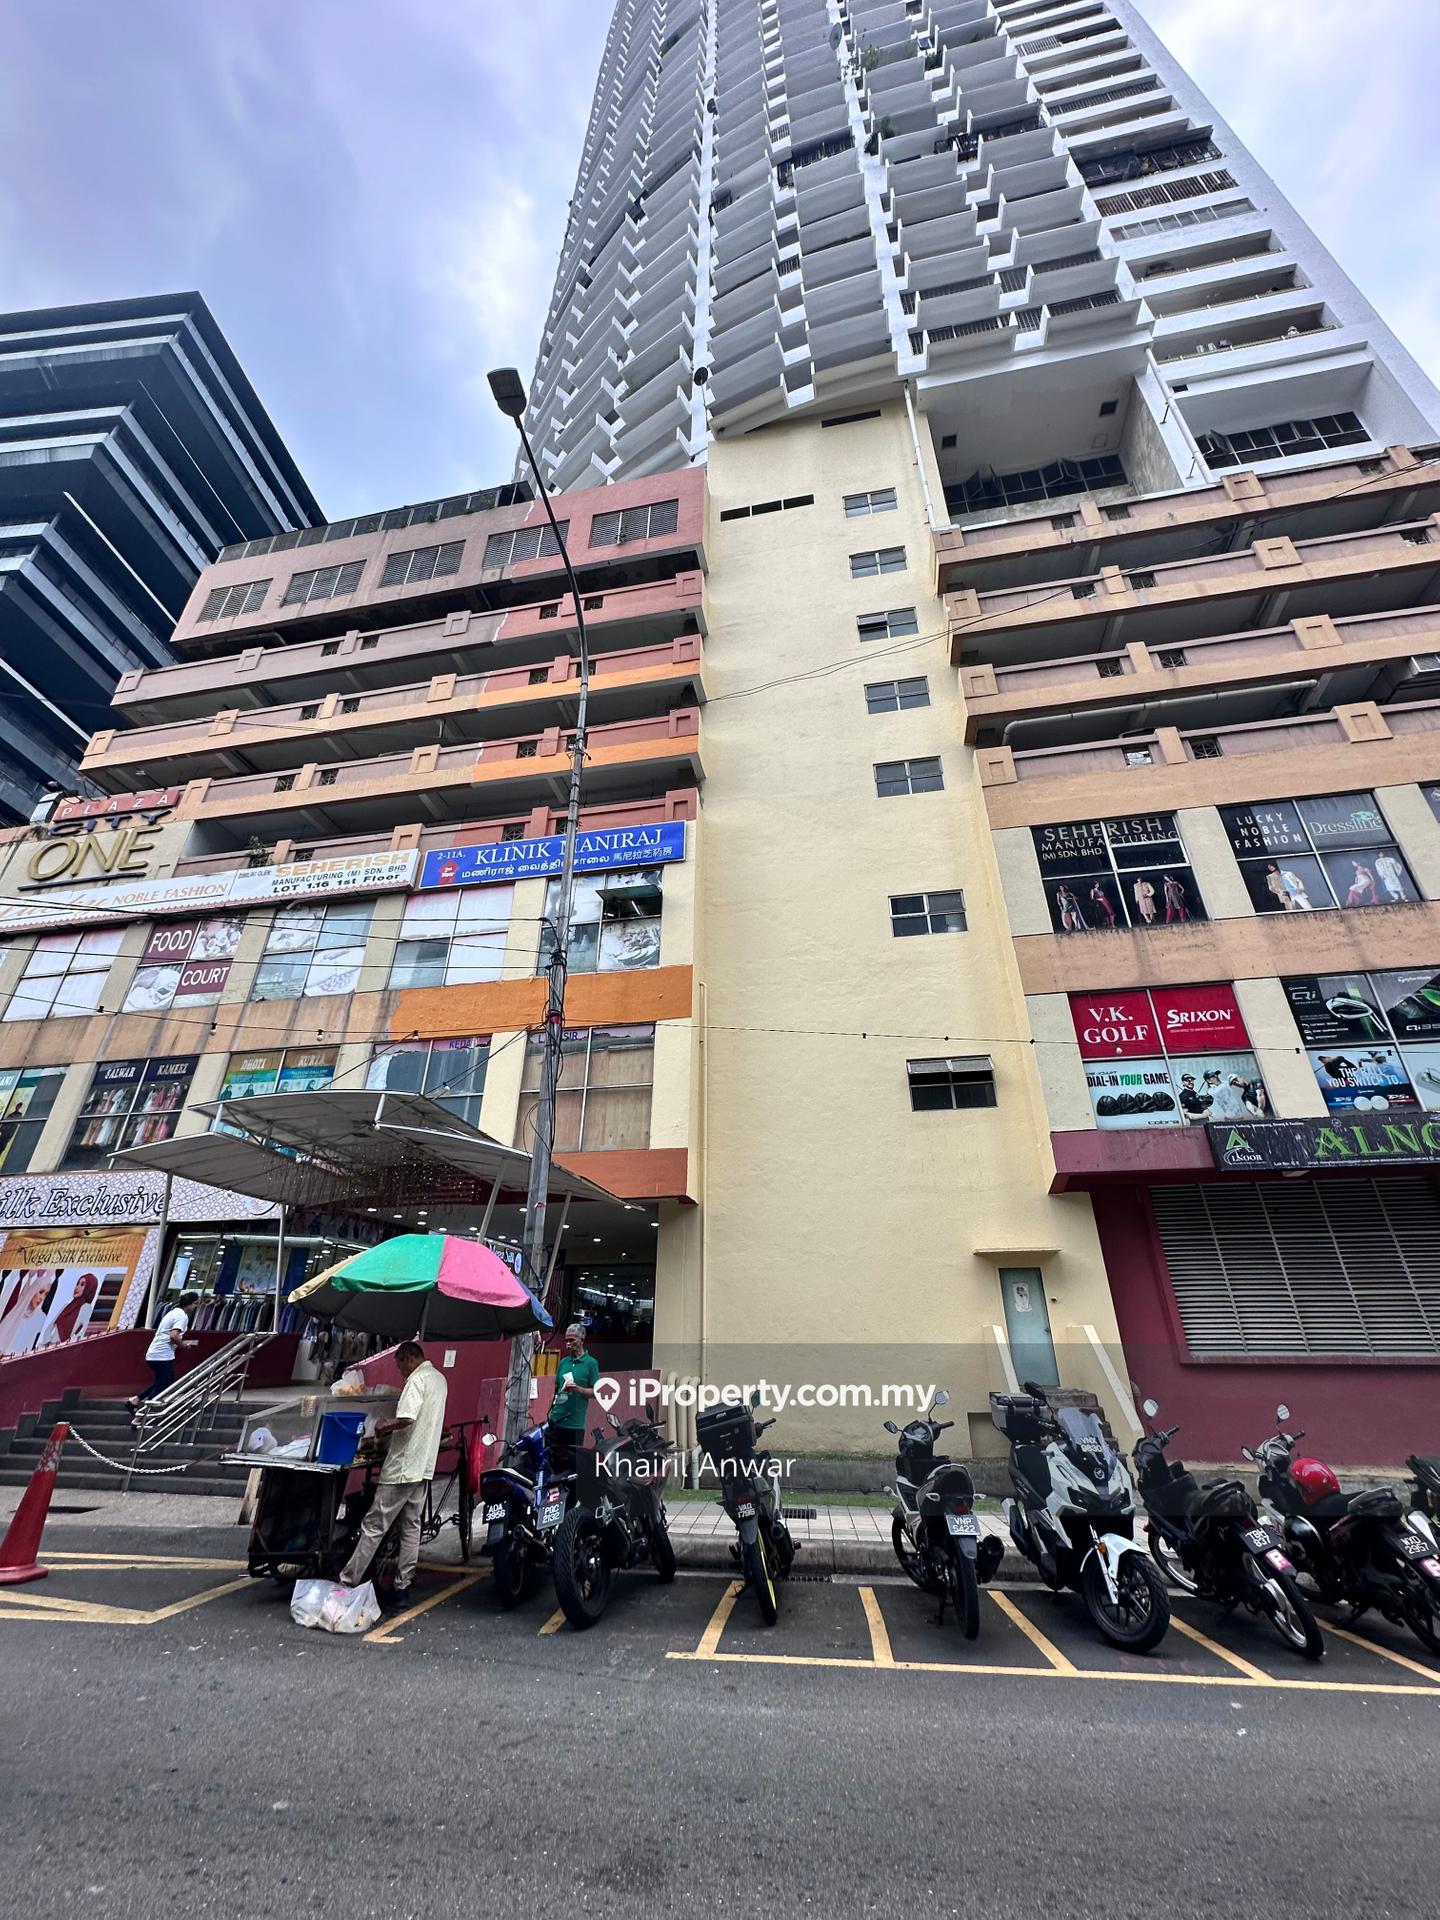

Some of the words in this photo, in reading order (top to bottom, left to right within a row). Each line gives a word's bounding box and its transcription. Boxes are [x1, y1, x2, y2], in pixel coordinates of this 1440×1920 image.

[61, 794, 168, 818] PLAZA
[50, 809, 173, 836] CITY
[1235, 812, 1283, 826] LUCKY
[1309, 815, 1384, 834] Dressline
[1044, 818, 1163, 842] SEHERISH
[1240, 823, 1290, 837] NOBLE
[475, 842, 551, 865] KLINIK
[559, 828, 663, 856] MANIRAJ
[1041, 830, 1178, 852] MANUFACTURING
[1234, 833, 1302, 849] FASHION
[27, 824, 163, 881] ONE
[1042, 852, 1057, 861] (M)
[1082, 847, 1105, 857] BHD.
[275, 853, 410, 878] SEHERISH
[272, 872, 343, 886] MANUFACTURING
[347, 870, 361, 878] (M)
[364, 867, 384, 875] SDN.
[388, 864, 408, 873] BHD.
[273, 885, 300, 894] LOT
[306, 880, 330, 889] 1.16
[337, 878, 356, 886] 1st
[363, 873, 401, 883] Floor
[113, 889, 160, 905] NOBLE
[164, 882, 228, 900] FASHION
[148, 928, 193, 954] FOOD
[181, 966, 230, 986] COURT
[1088, 1006, 1134, 1023] V.K.
[1166, 1009, 1231, 1027] SRIXON
[1083, 1025, 1149, 1044] GOLF
[105, 1067, 136, 1080] SALWAR
[157, 1063, 189, 1076] KAMEEZ
[1338, 1067, 1357, 1078] THE
[1086, 1074, 1119, 1088] DIAL-IN
[1120, 1073, 1142, 1086] YOUR
[1143, 1072, 1170, 1085] GAME
[1326, 1077, 1346, 1088] YOU
[1349, 1075, 1385, 1087] SWITCH
[0, 1187, 41, 1219] ilk
[39, 1186, 172, 1217] Exclusive
[76, 1248, 122, 1263] Exclusive
[542, 1512, 560, 1524] 2132
[953, 1517, 972, 1525] VNP
[952, 1524, 976, 1533] 5422
[1245, 1528, 1267, 1540] TBH
[1253, 1534, 1271, 1547] 837
[1404, 1542, 1429, 1554] 2957
